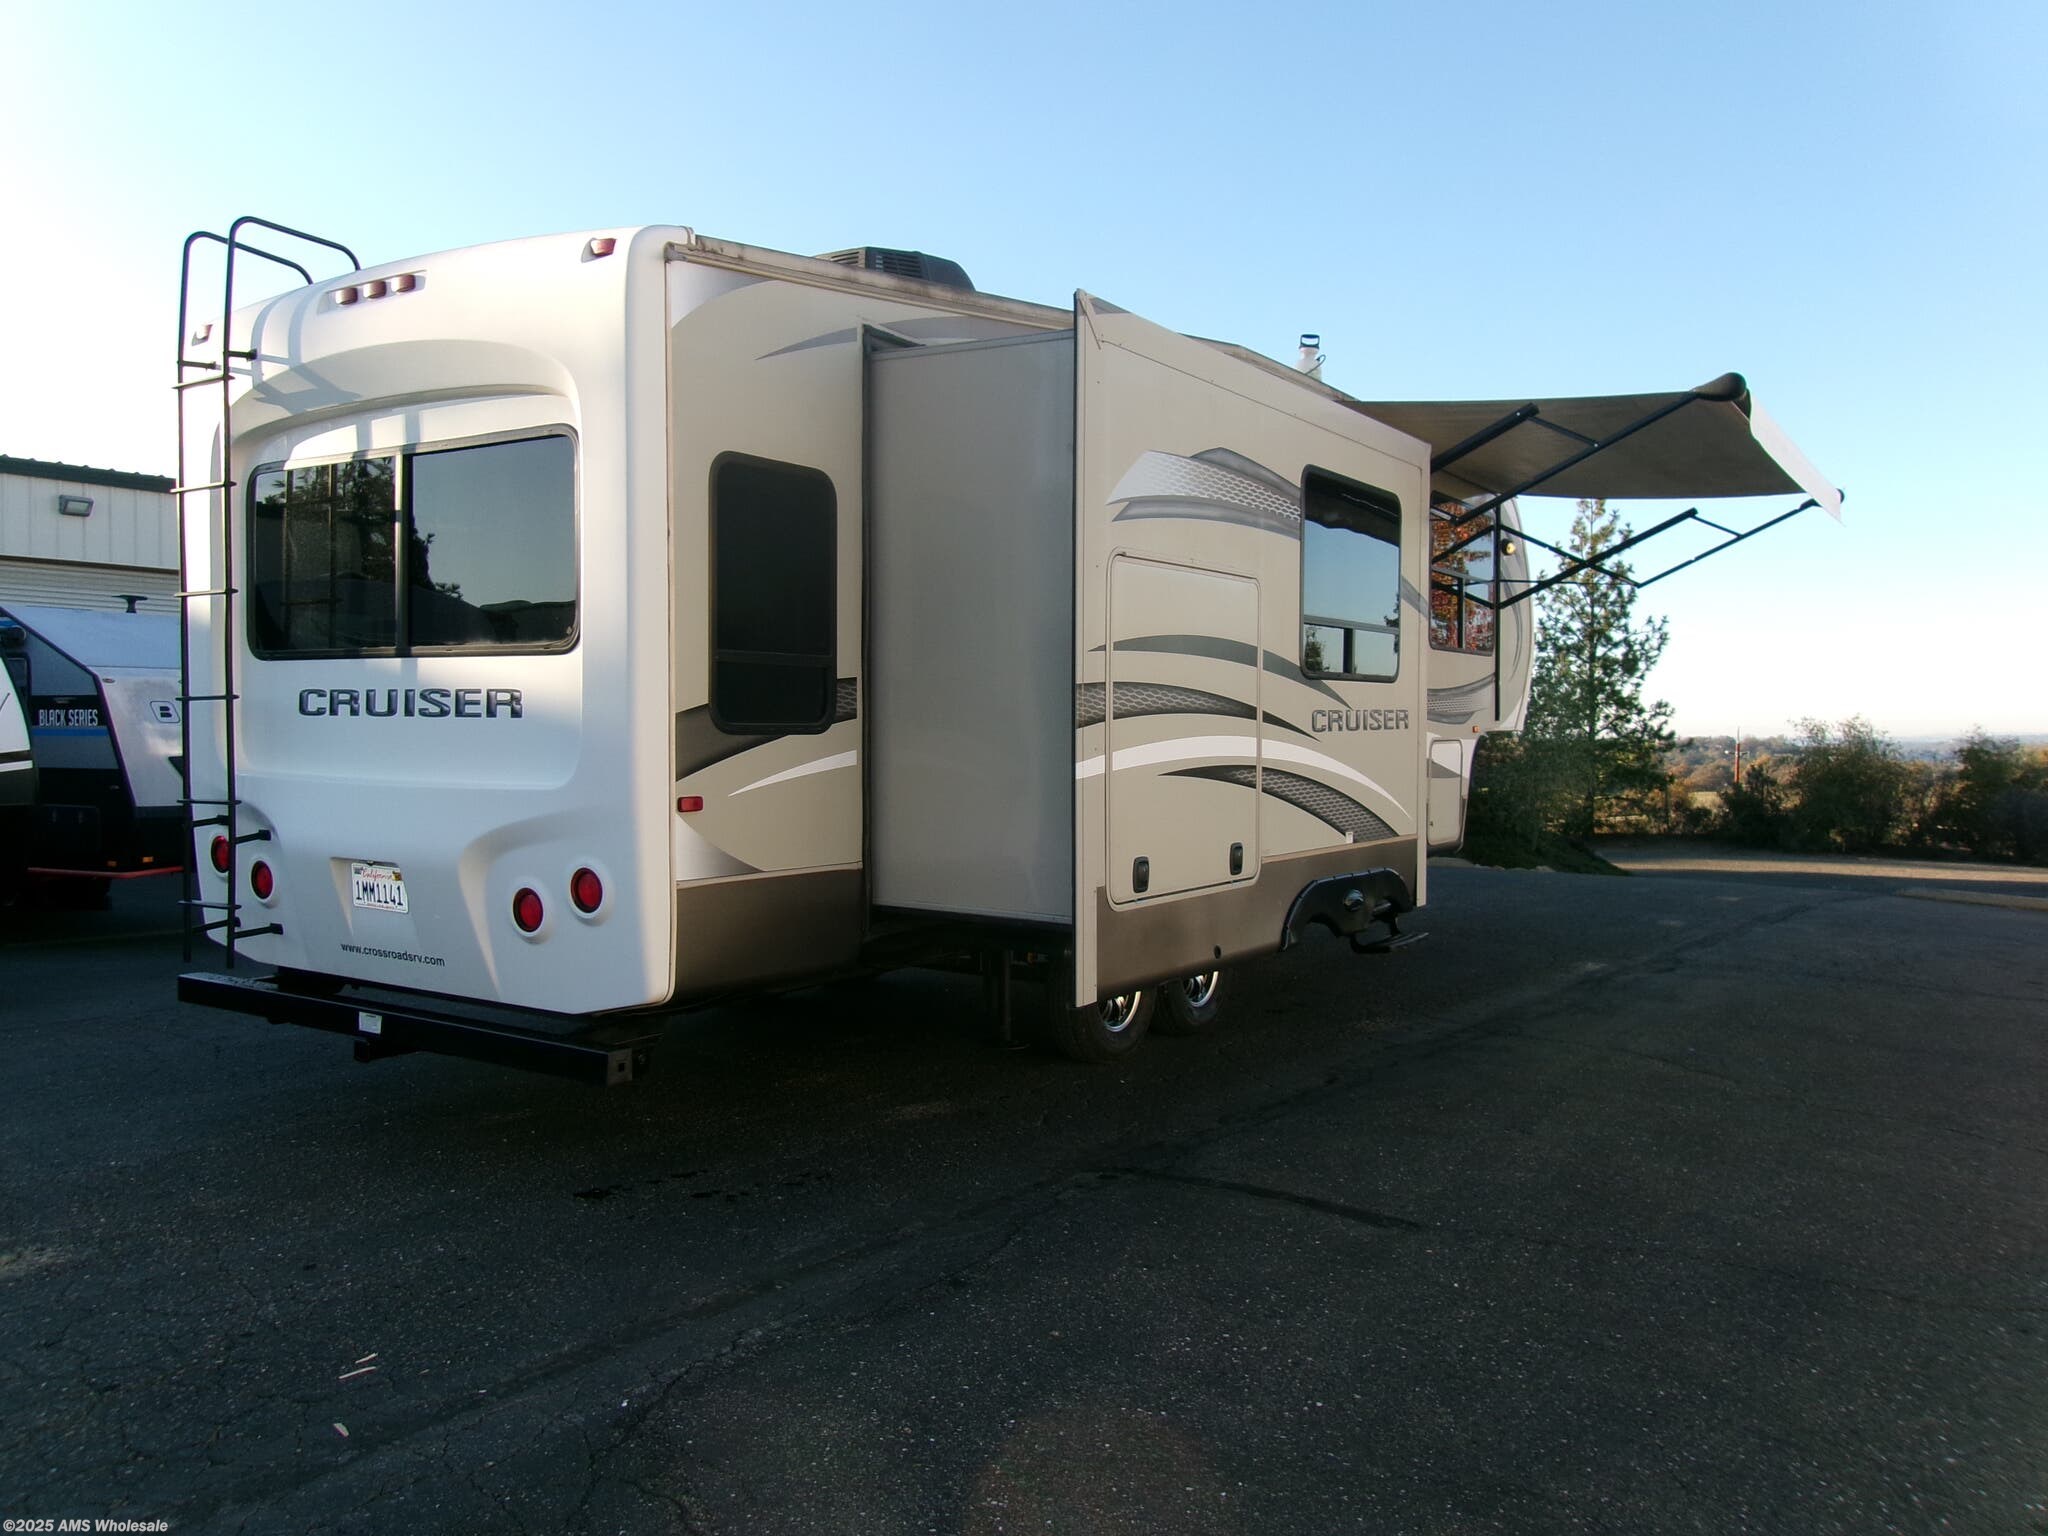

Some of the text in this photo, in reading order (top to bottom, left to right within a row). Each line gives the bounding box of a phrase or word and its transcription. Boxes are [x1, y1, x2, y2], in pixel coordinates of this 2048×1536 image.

[298, 688, 523, 719] CRUISER
[39, 709, 99, 727] BLACK SERIES
[1311, 709, 1409, 733] CRUISER
[355, 880, 404, 906] 1MM1141
[340, 943, 446, 967] www.crossroadsrv.com
